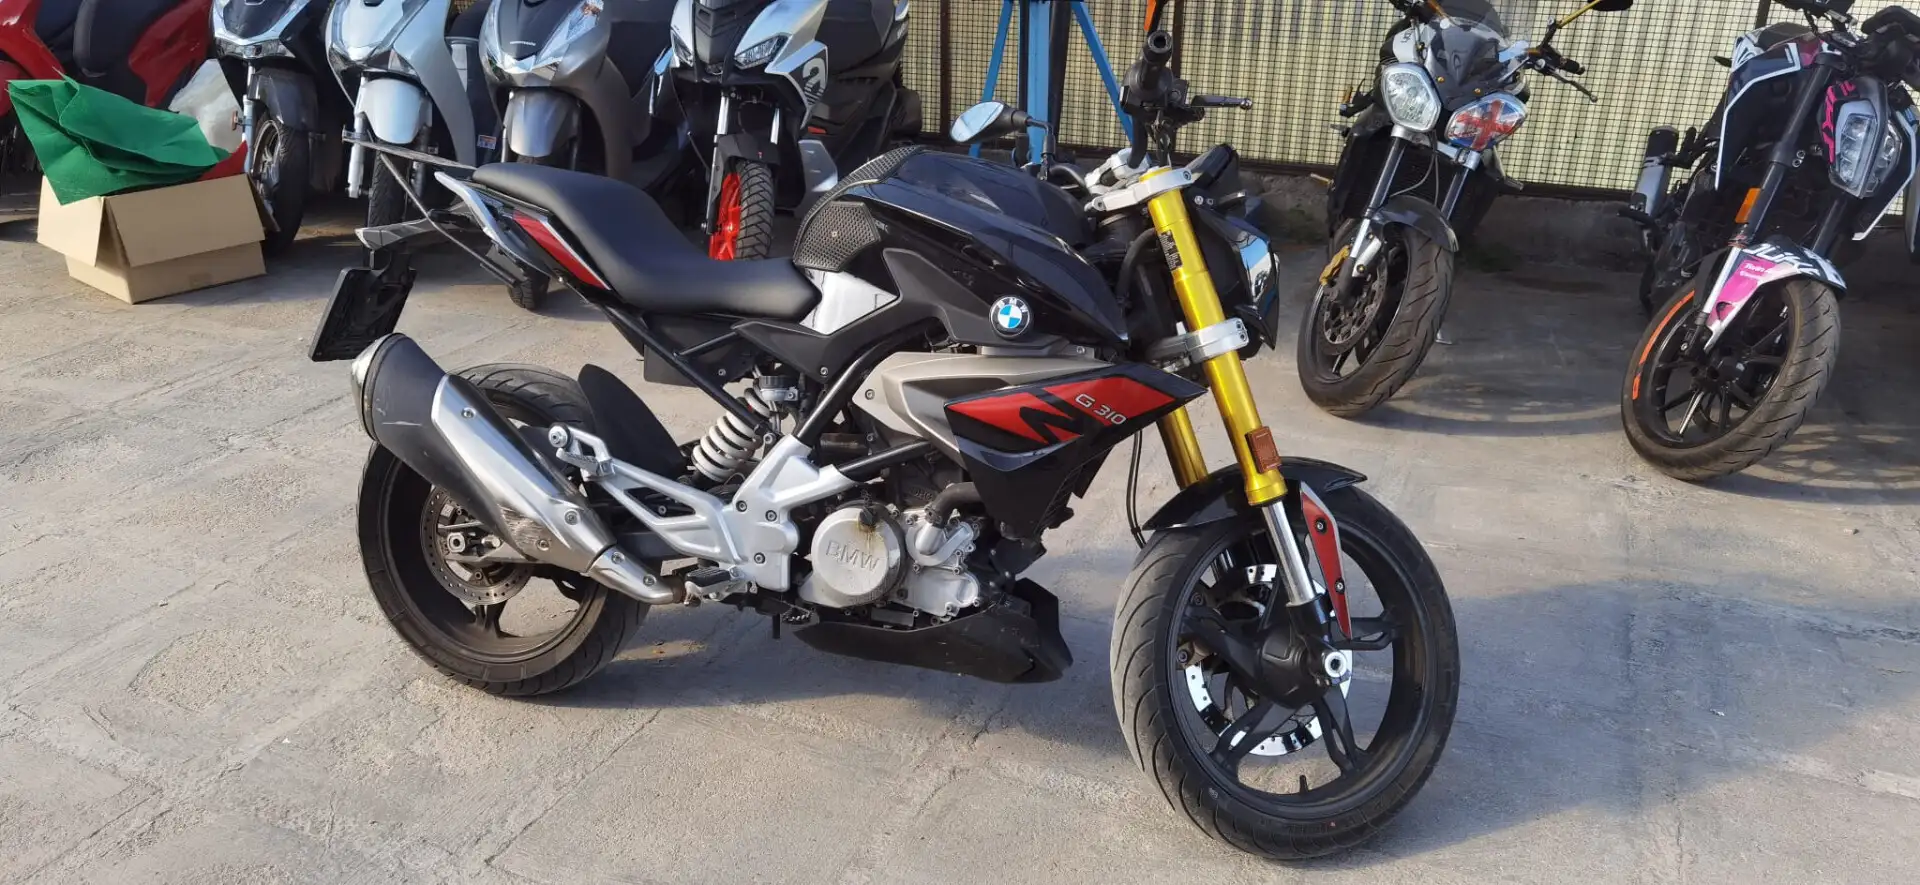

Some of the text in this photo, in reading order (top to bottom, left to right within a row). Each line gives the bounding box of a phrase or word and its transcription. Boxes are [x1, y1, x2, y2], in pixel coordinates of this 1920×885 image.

[997, 297, 1029, 313] BMW
[1075, 393, 1096, 408] G
[1093, 404, 1127, 425] 310
[825, 539, 881, 572] BMW
